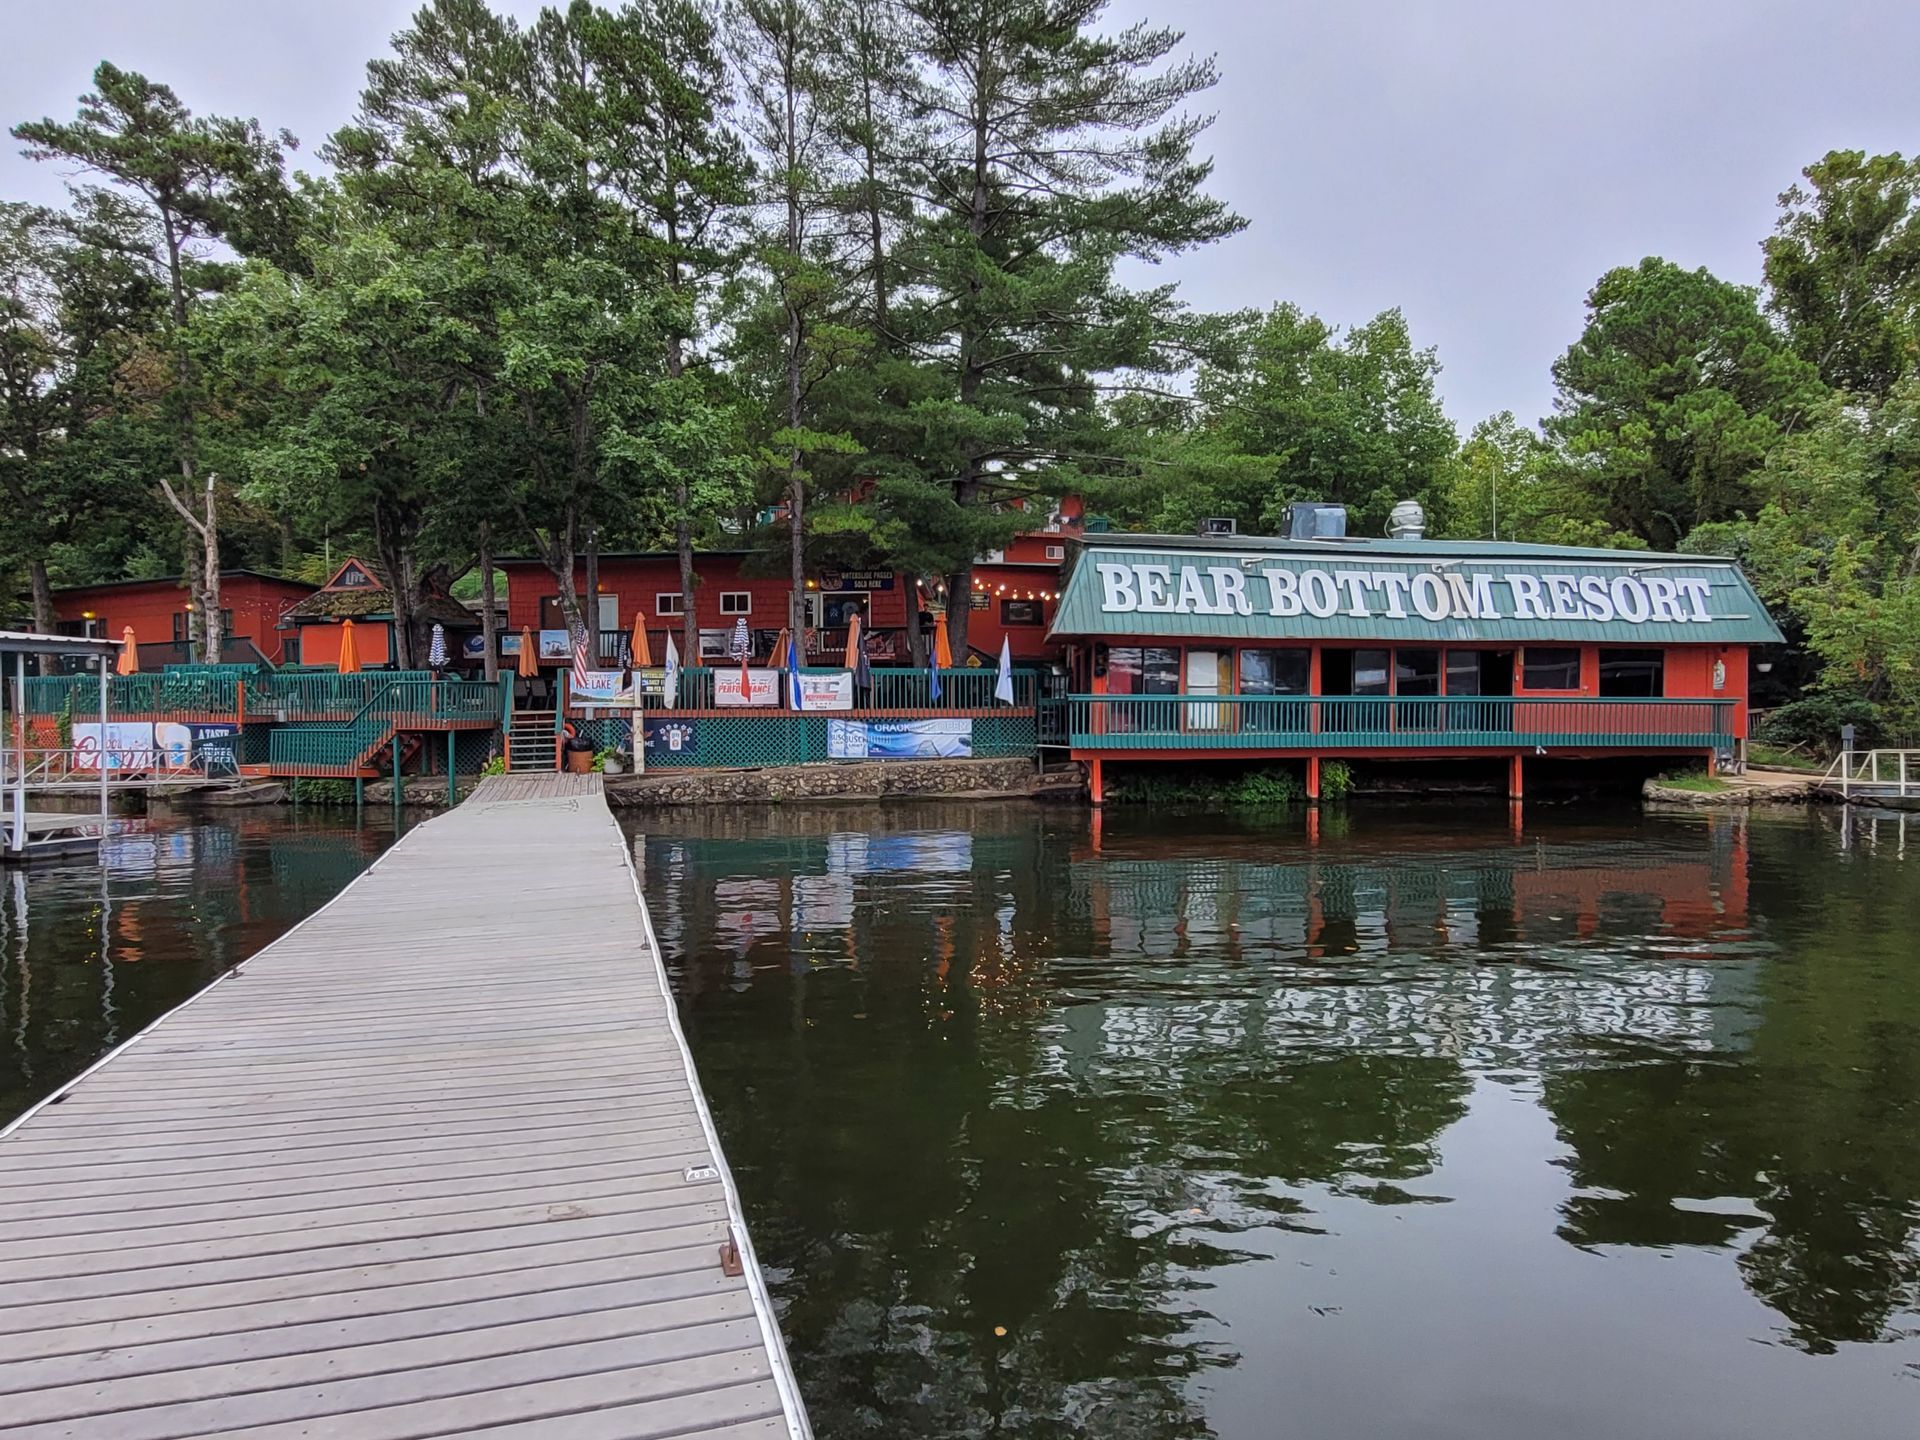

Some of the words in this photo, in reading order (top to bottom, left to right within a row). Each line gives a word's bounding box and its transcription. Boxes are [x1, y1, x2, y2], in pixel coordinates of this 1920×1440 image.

[841, 571, 872, 579] WATERSLIDE
[873, 571, 893, 579] PASSES
[854, 580, 867, 588] SOLD
[868, 580, 882, 588] HERE
[1096, 563, 1253, 616] BEAR
[1262, 568, 1501, 621] BOTTOM
[1505, 573, 1713, 623] RESORT
[592, 680, 611, 689] LAKE
[719, 684, 772, 693] PERFOANCE
[874, 724, 910, 732] CRACK
[198, 728, 205, 739] A
[205, 728, 230, 739] TASTE
